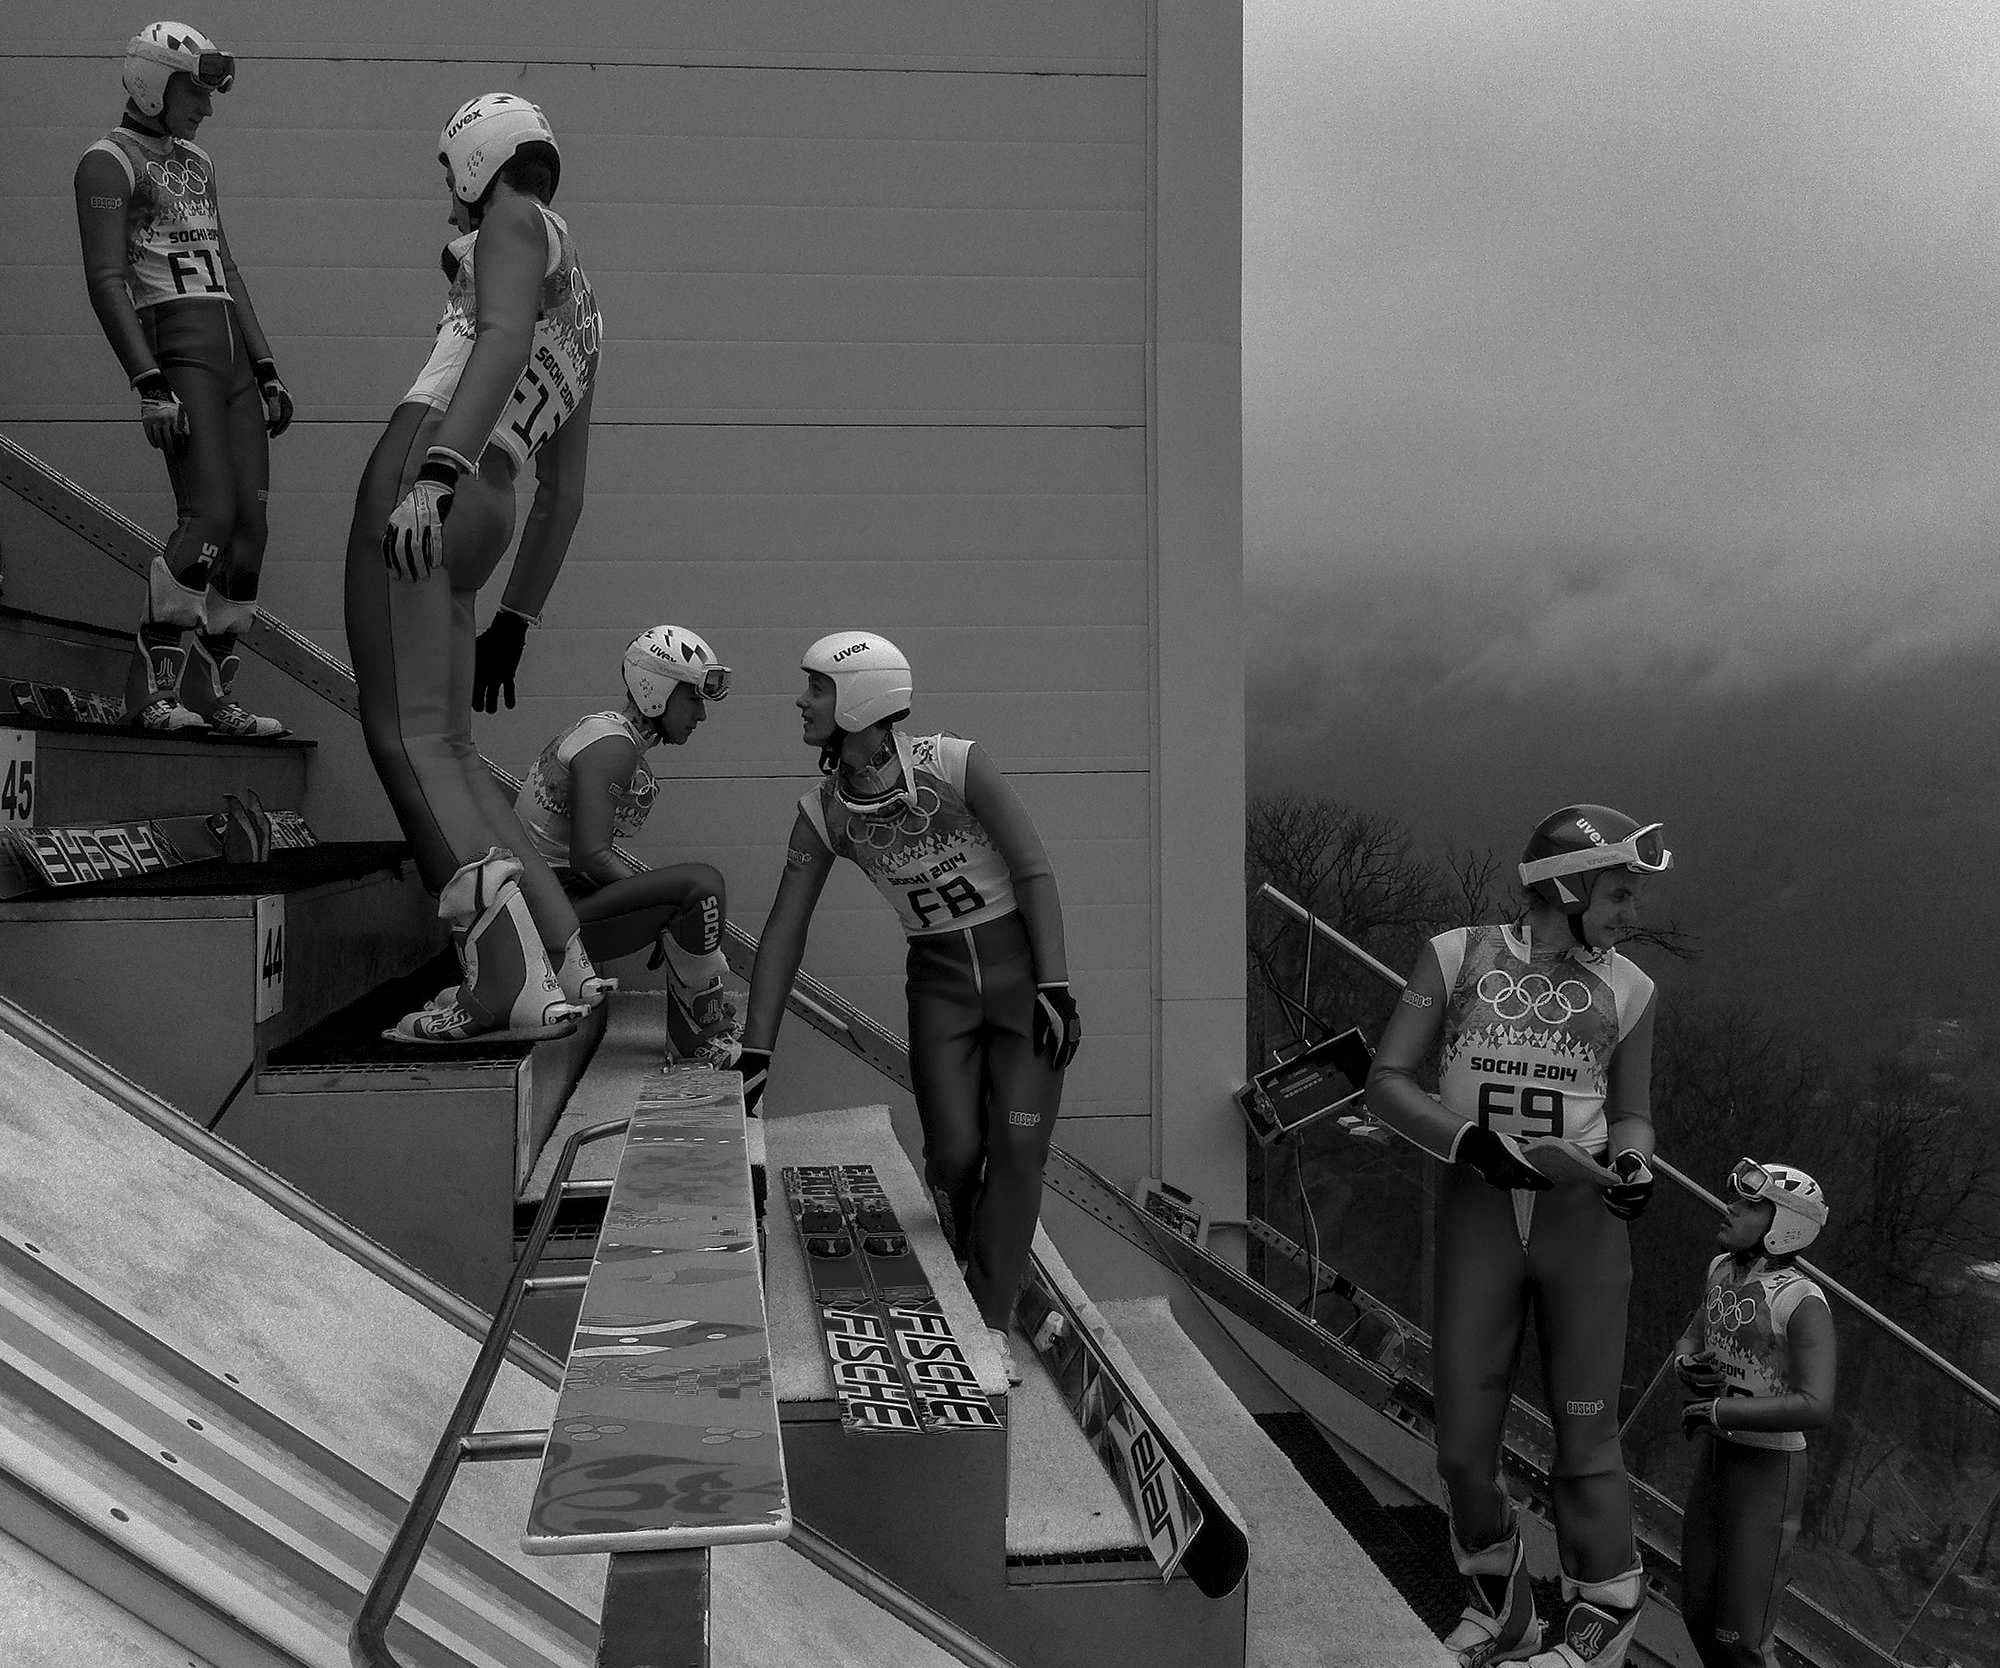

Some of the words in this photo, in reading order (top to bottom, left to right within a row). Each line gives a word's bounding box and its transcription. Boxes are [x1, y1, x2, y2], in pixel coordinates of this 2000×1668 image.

[448, 108, 483, 138] uvex
[534, 346, 565, 389] SOCHI
[833, 641, 870, 662] uvex
[1, 760, 33, 821] 45
[33, 826, 167, 886] FISCHE
[929, 852, 967, 880] 2014
[700, 895, 720, 951] SOCHI
[262, 925, 283, 989] 44
[1470, 1056, 1529, 1076] SOCHI
[1533, 1063, 1578, 1082] 2014
[1479, 1082, 1564, 1138] F9
[823, 1308, 921, 1430] FISCHE
[889, 1308, 1005, 1430] FISCHE
[1720, 1360, 1746, 1381] 2014
[1567, 1401, 1598, 1415] BOSCO
